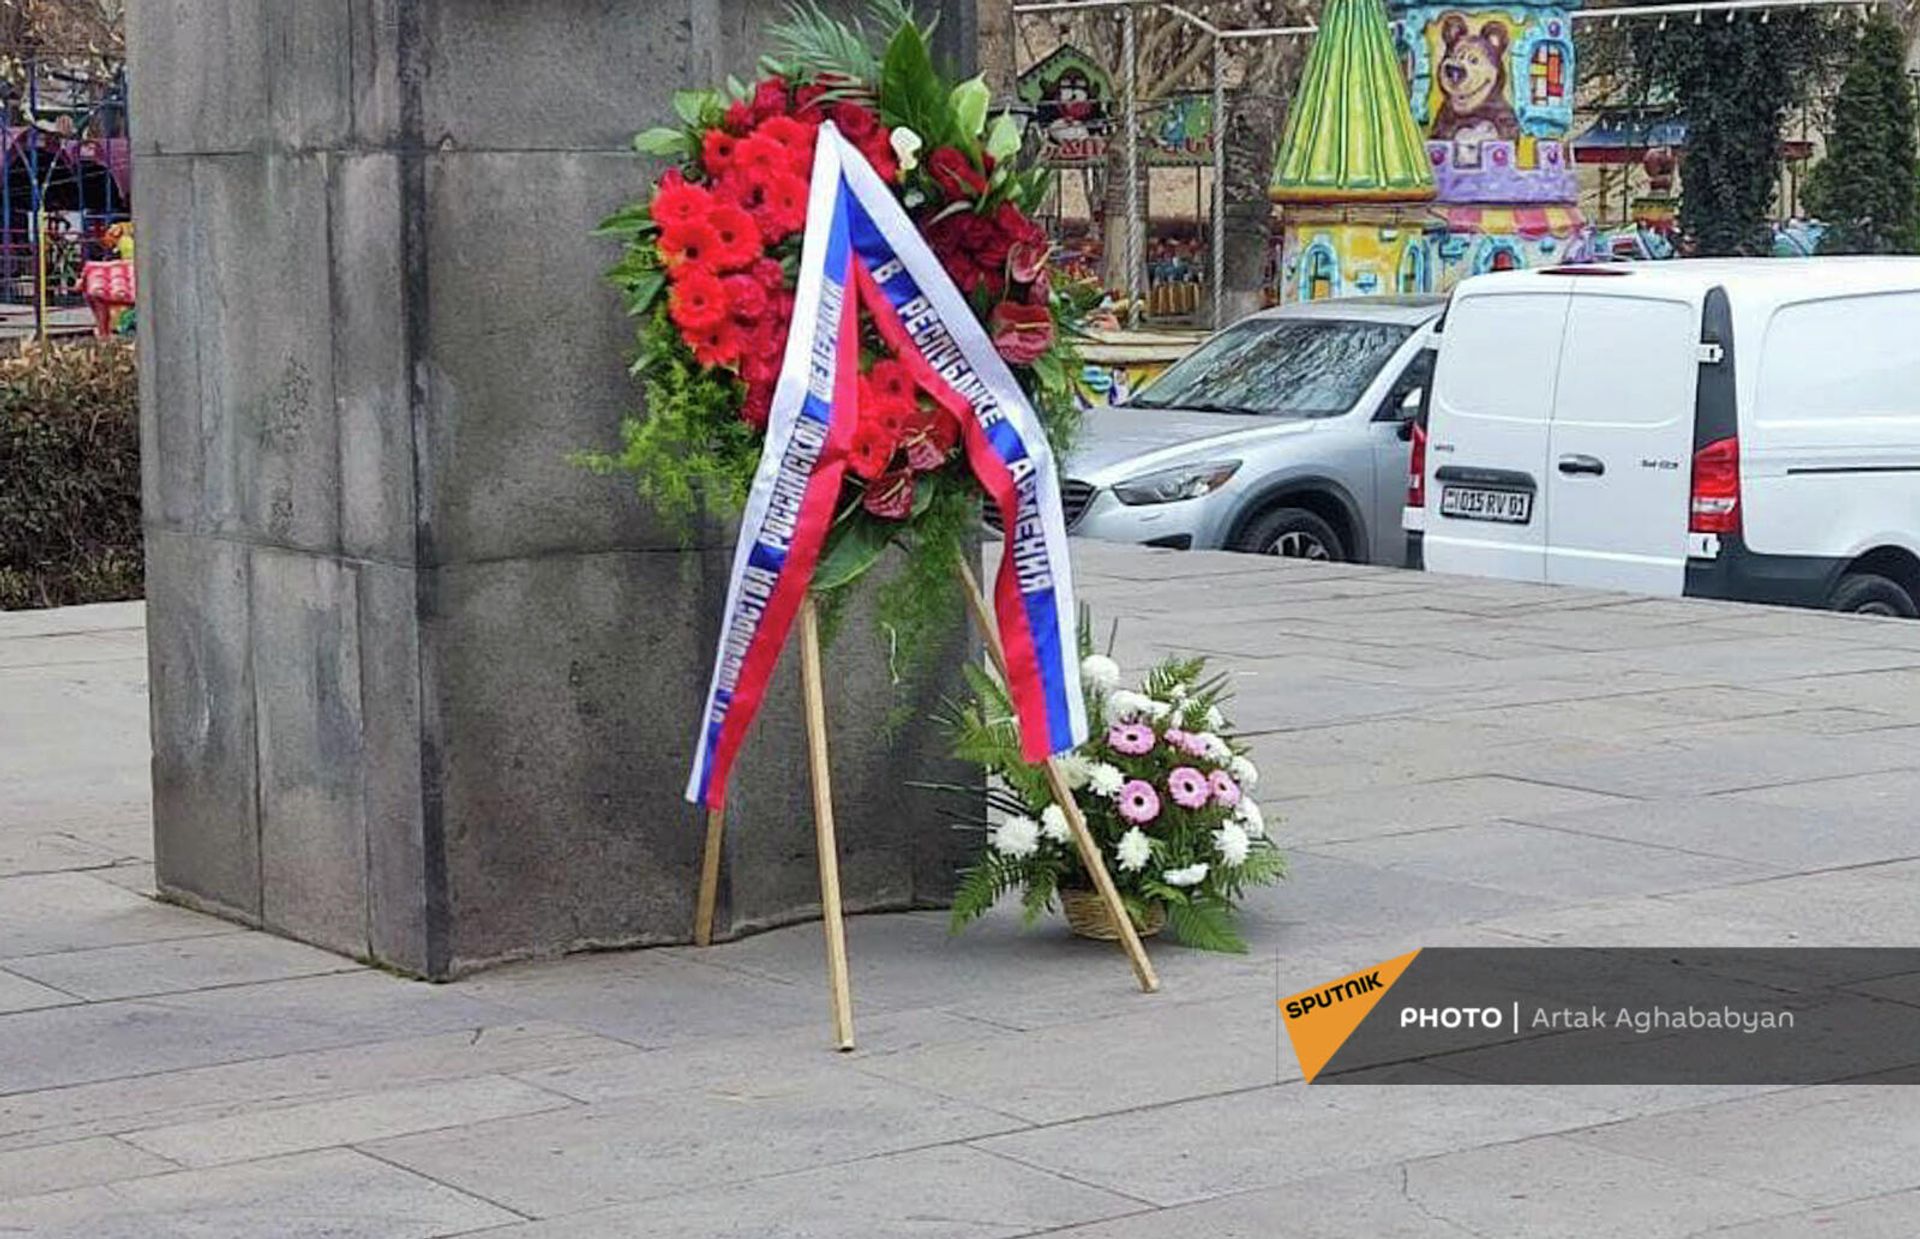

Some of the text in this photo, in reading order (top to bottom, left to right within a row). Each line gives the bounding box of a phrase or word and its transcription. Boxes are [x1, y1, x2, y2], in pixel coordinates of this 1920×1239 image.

[873, 257, 1053, 592] В РЕСПУБЛИКЕ АРМЕНИЯ
